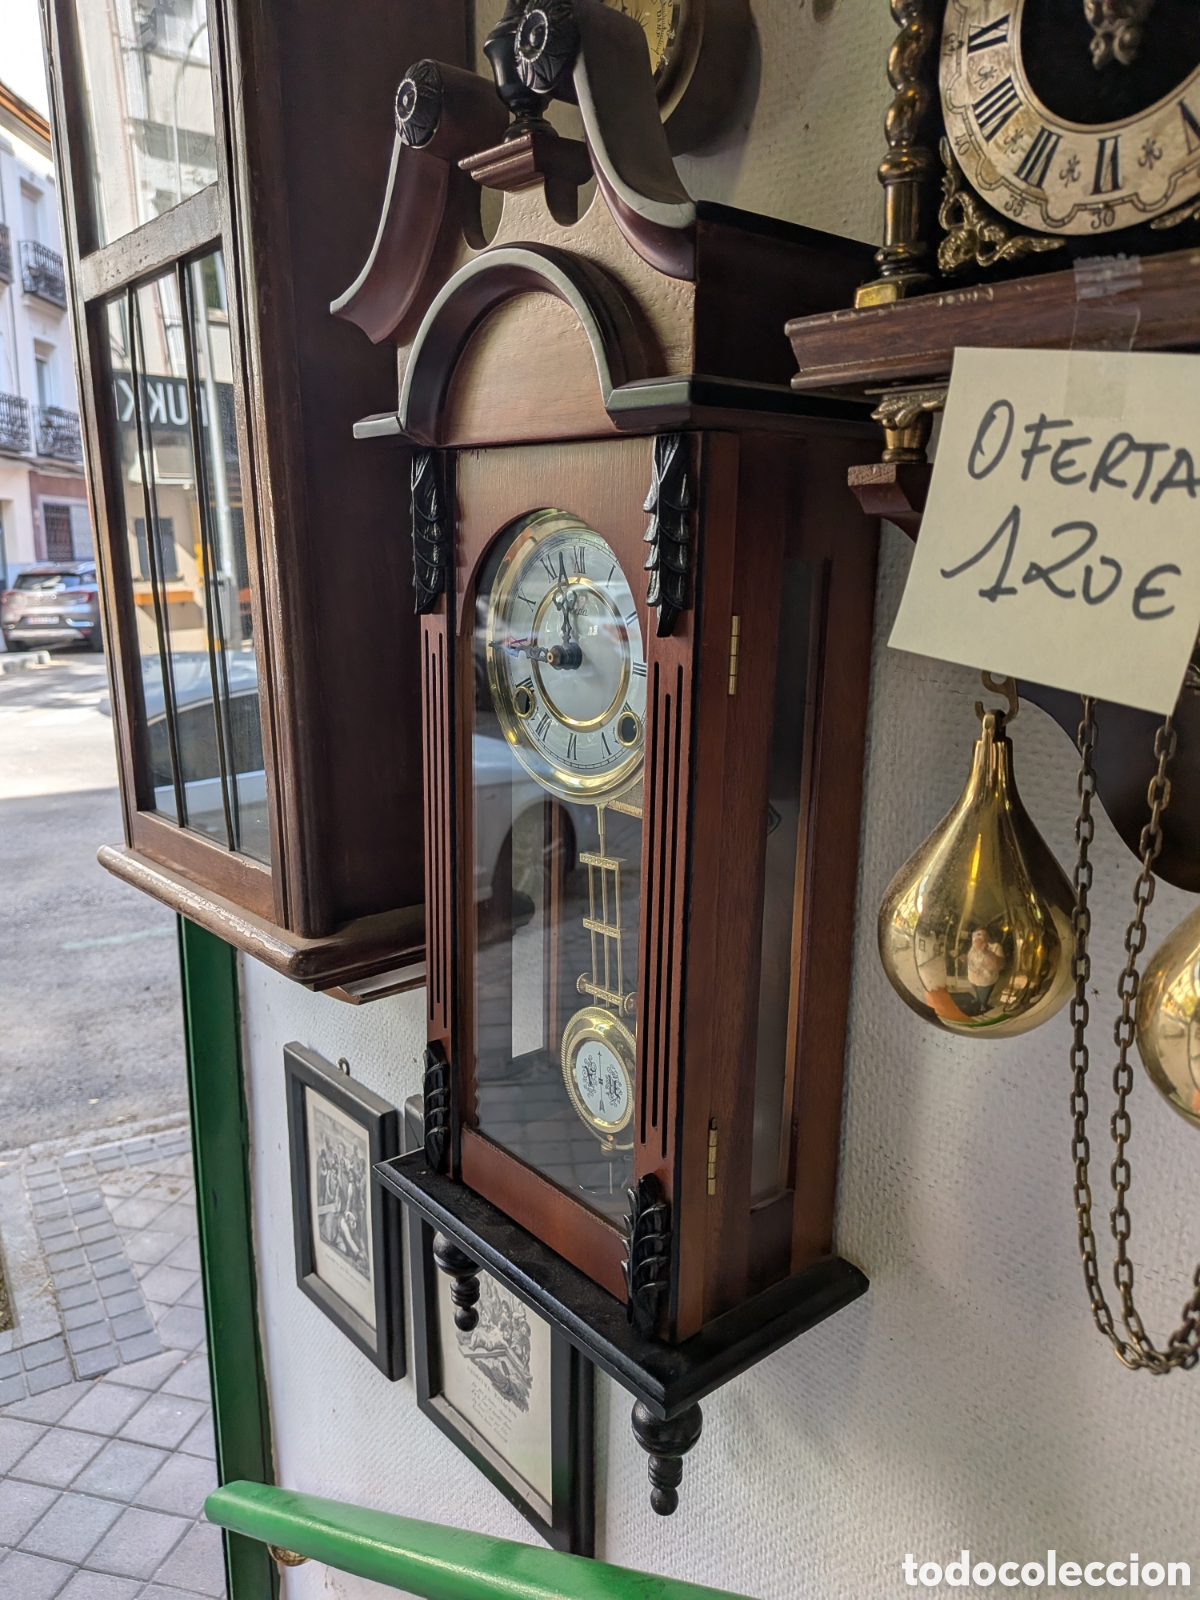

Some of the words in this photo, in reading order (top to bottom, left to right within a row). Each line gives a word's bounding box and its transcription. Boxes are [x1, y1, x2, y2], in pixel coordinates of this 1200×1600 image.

[1003, 195, 1024, 217] 35
[1090, 207, 1116, 229] 30
[968, 399, 1200, 504] OFERTA
[940, 504, 1181, 620] 120€
